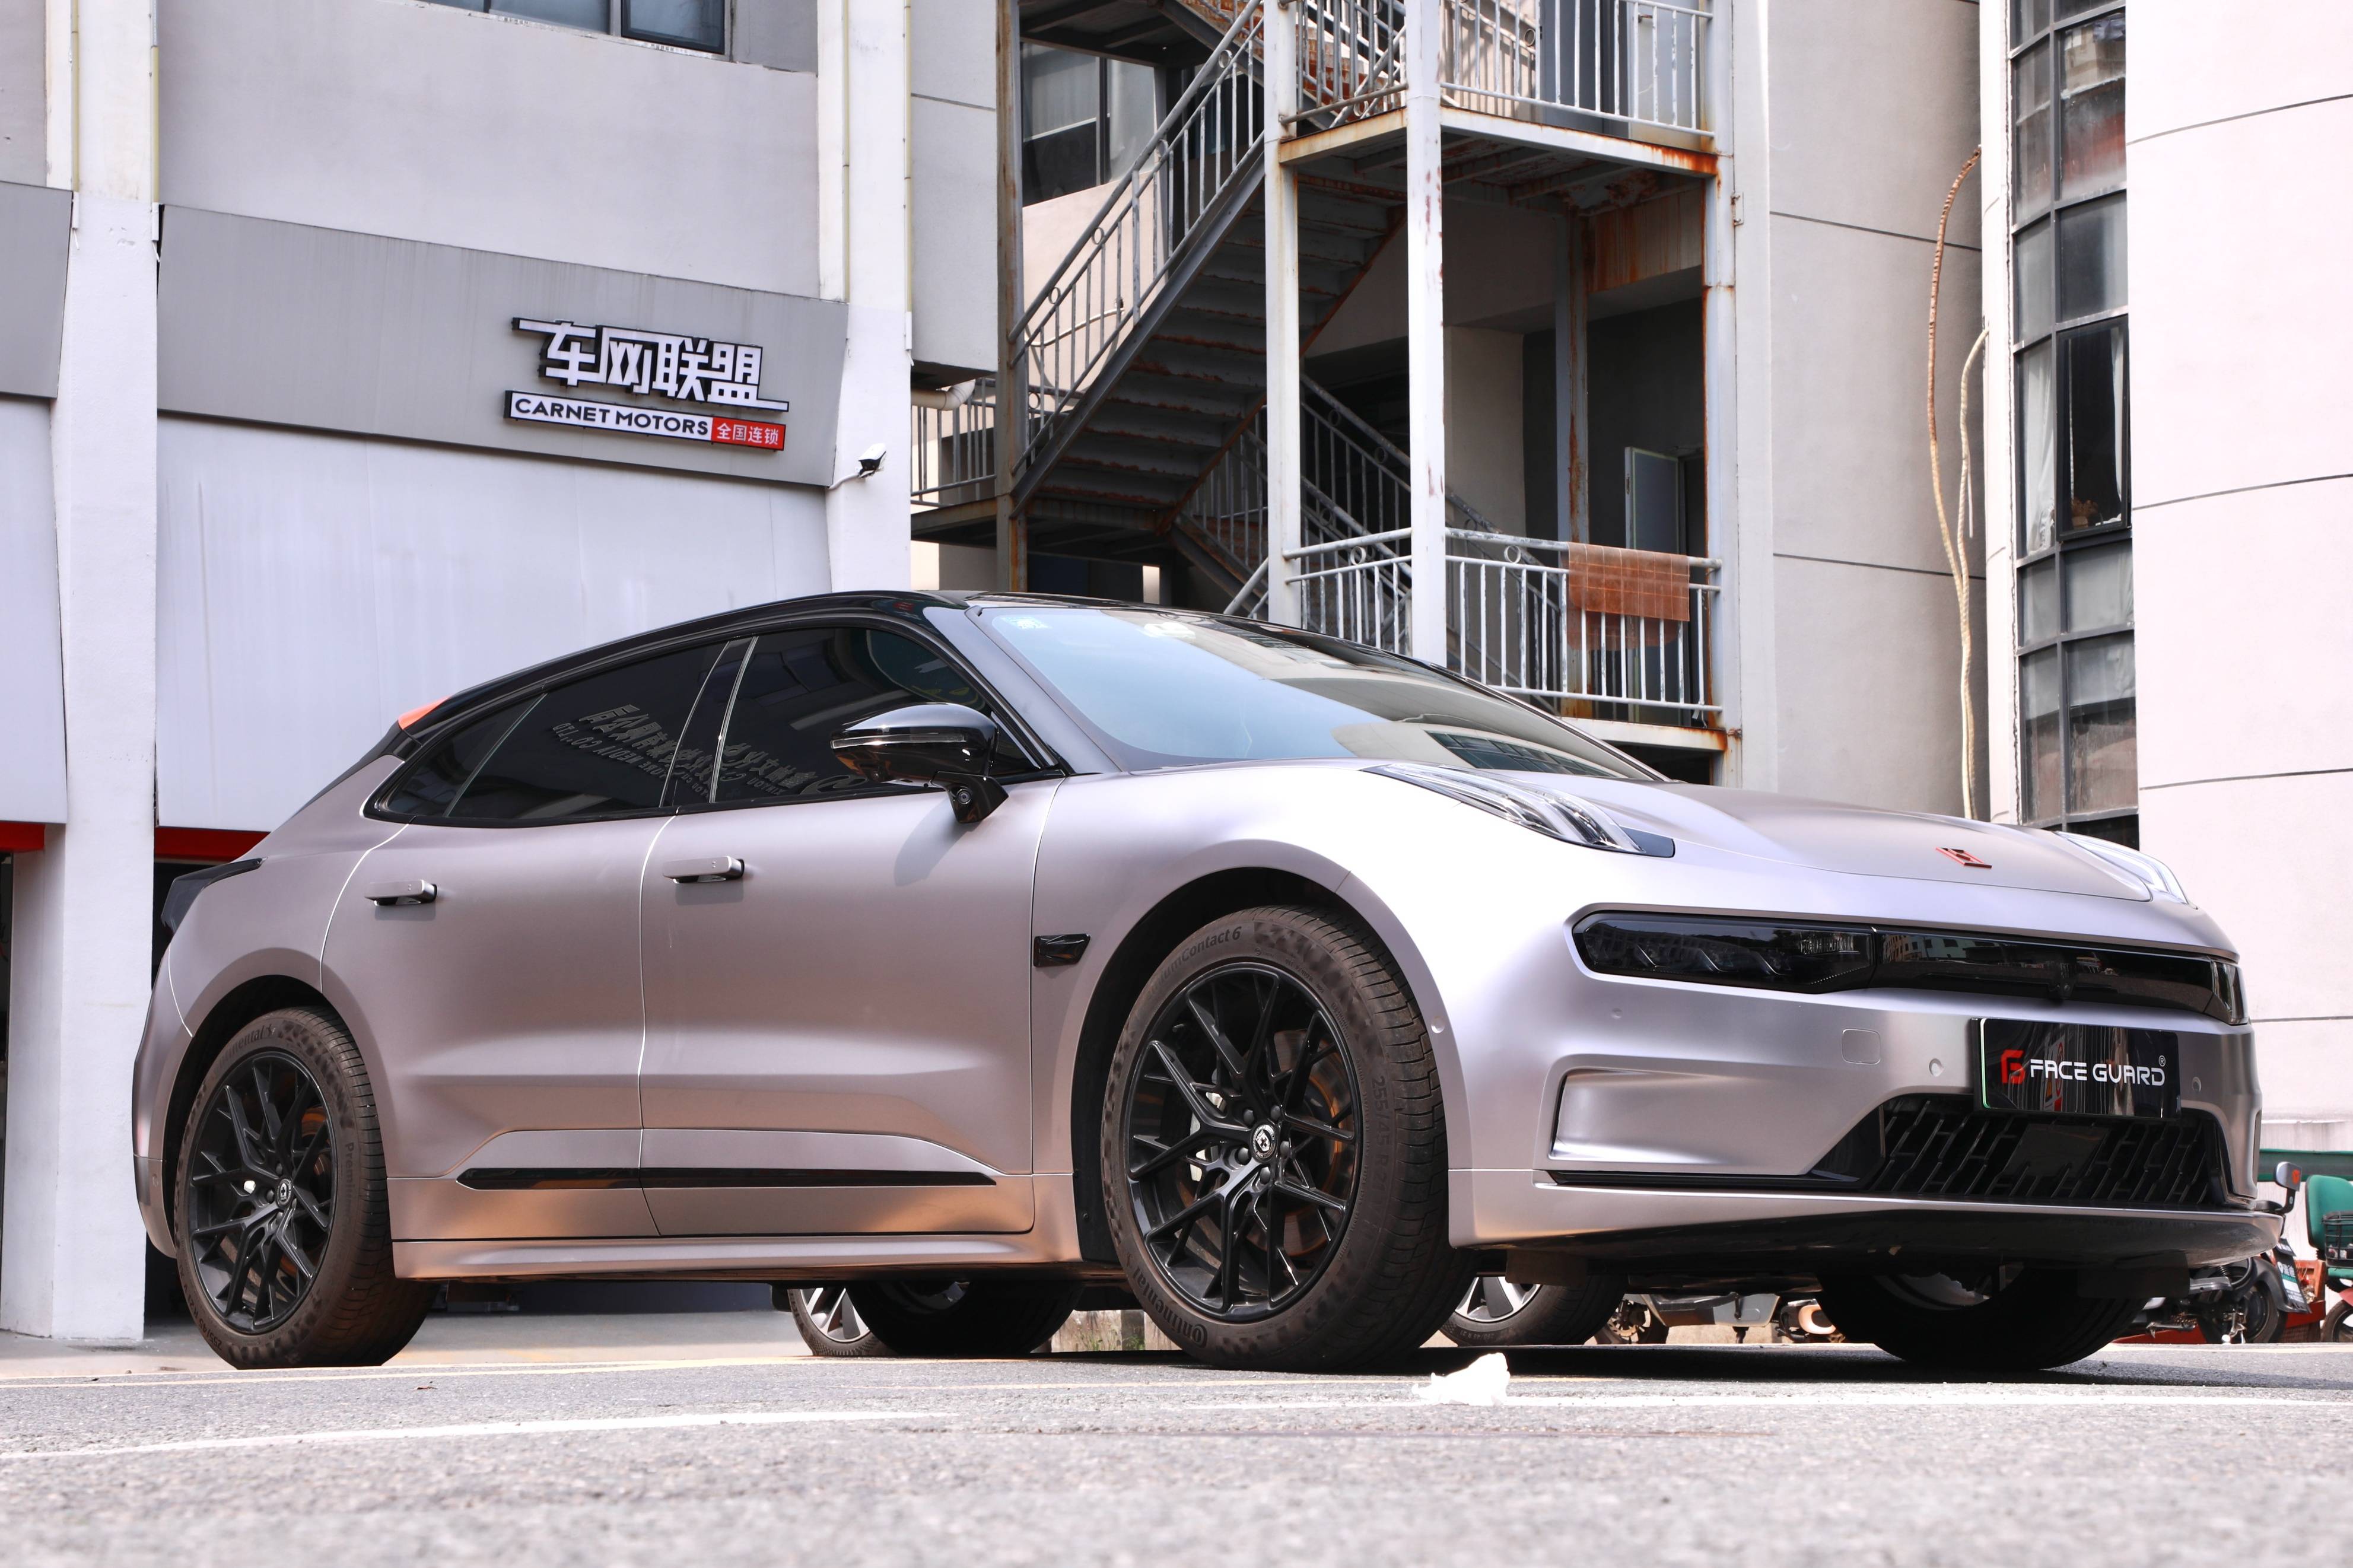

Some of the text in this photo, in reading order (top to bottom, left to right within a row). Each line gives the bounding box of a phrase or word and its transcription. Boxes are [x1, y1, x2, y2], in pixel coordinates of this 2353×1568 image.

[515, 318, 789, 411] 车网联盟
[515, 398, 708, 436] CARNET MOTORS
[716, 422, 780, 446] 全国连锁
[1231, 925, 1242, 941] 6
[2030, 1058, 2088, 1081] FACE
[2093, 1063, 2166, 1087] GUARD
